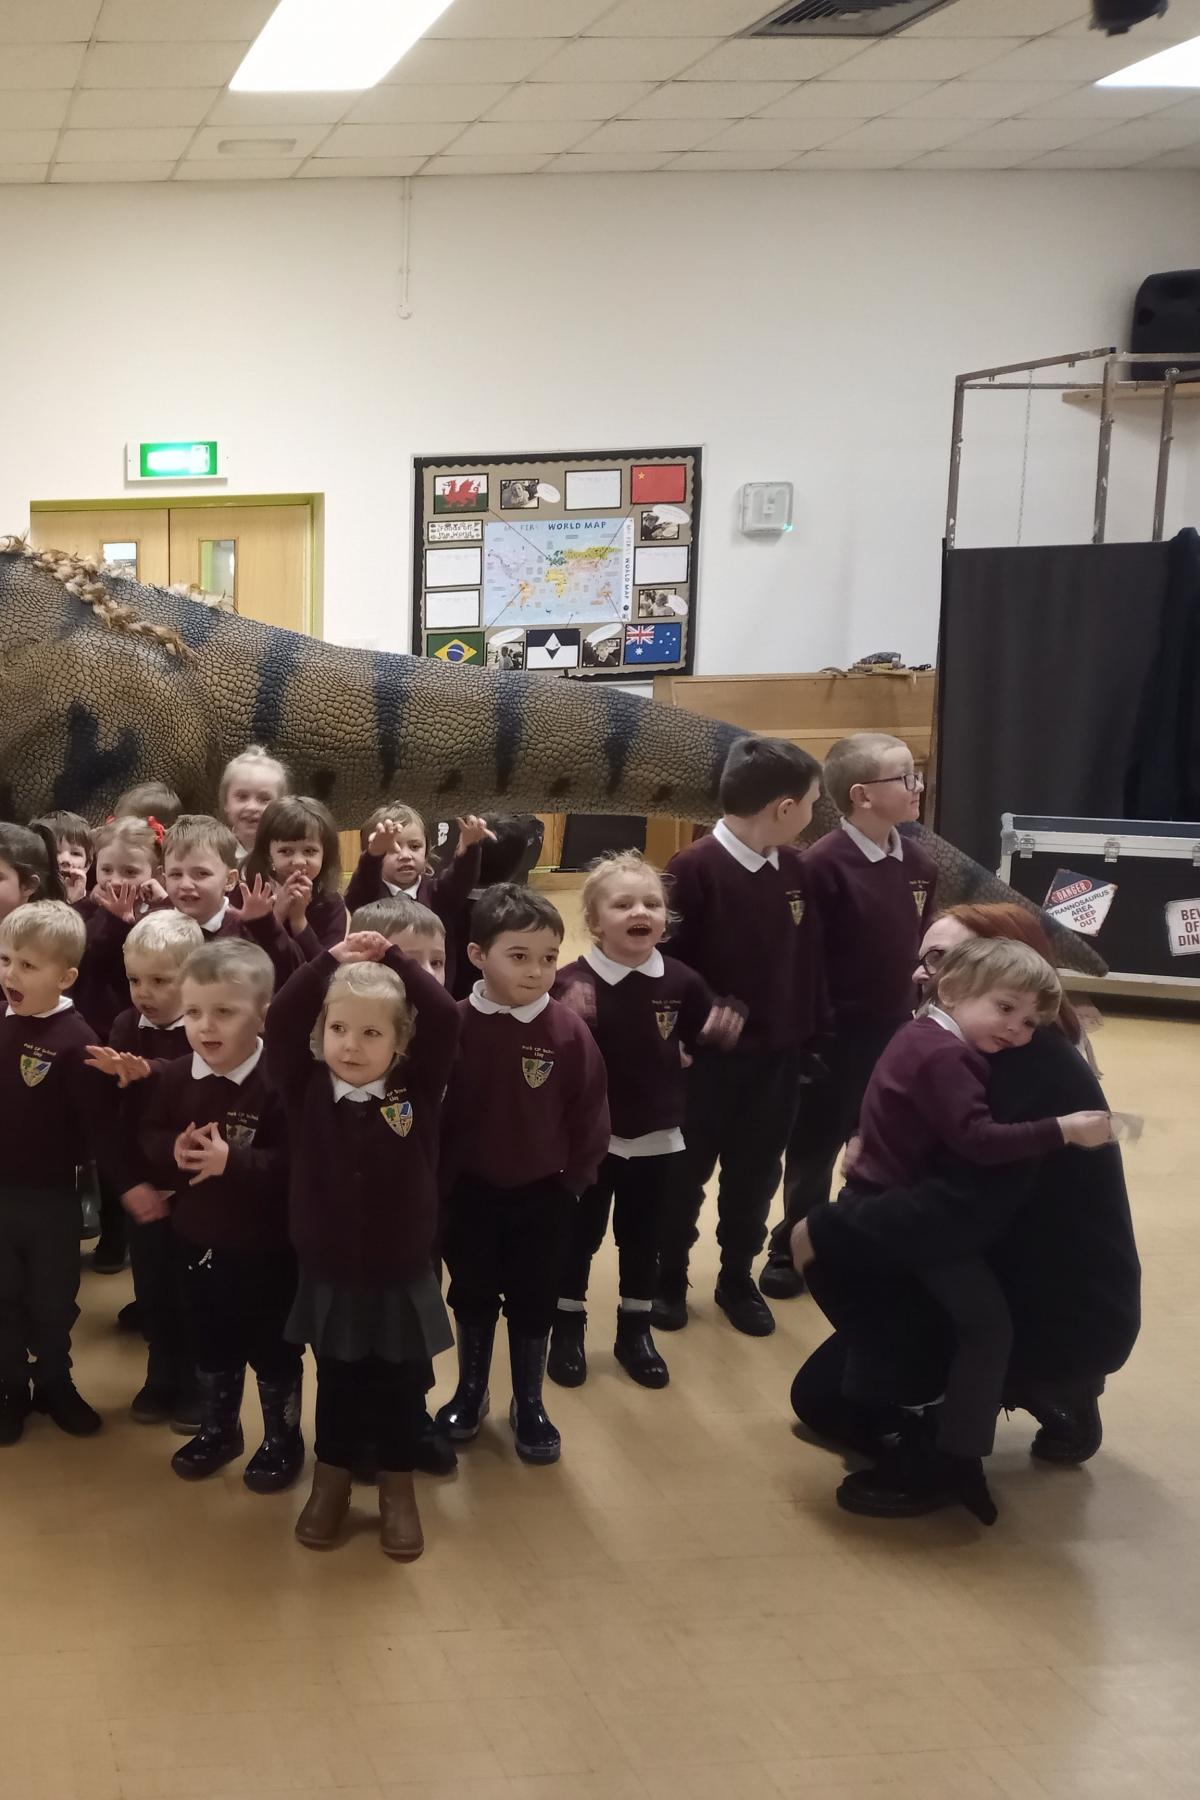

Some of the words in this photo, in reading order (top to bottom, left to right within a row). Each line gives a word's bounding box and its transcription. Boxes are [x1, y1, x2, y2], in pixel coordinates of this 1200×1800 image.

[548, 522, 581, 531] WORLD
[584, 521, 607, 529] MAP
[1056, 882, 1087, 900] DANGER
[1049, 890, 1110, 917] YRANNOSAURUS
[1071, 904, 1093, 917] AREA
[1073, 910, 1096, 923] KEEP
[1080, 917, 1097, 928] OUT
[1185, 921, 1200, 933] OF
